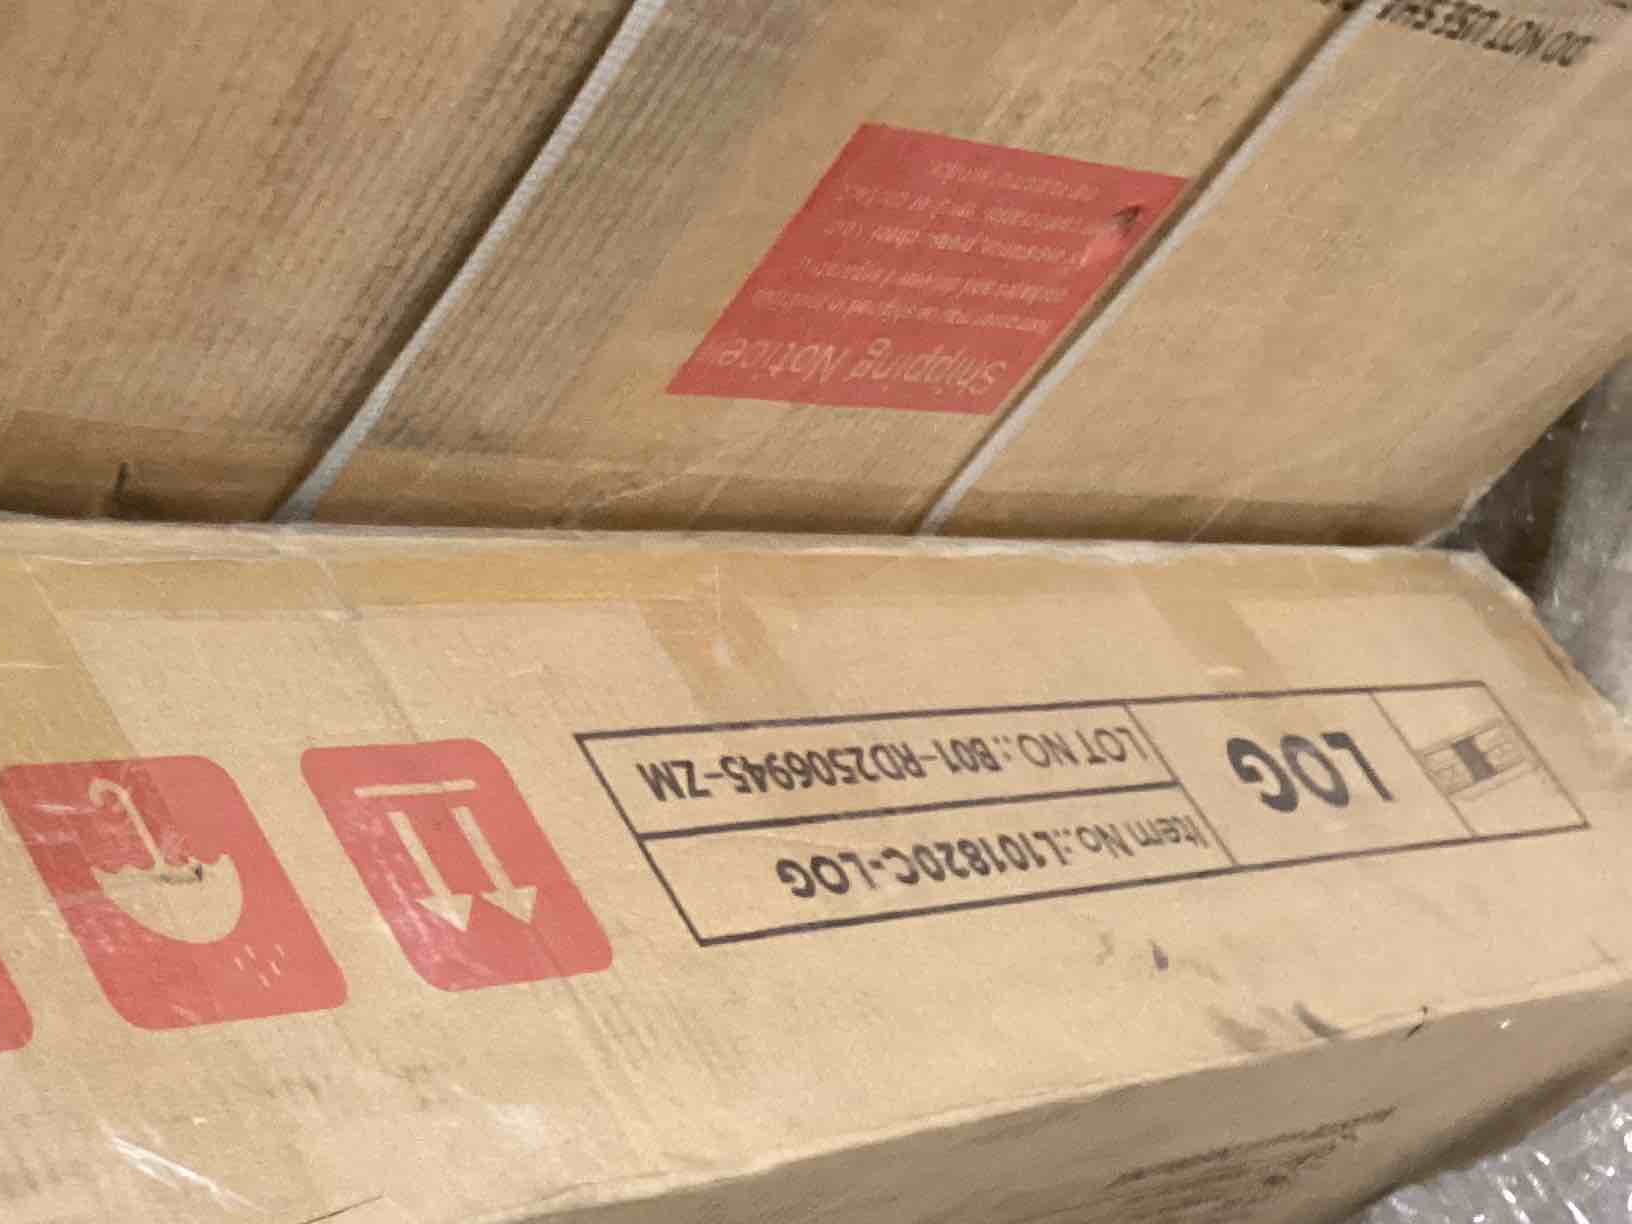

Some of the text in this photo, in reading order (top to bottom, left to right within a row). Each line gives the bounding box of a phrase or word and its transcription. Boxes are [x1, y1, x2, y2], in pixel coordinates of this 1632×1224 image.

[1482, 20, 1550, 55] NOT
[720, 338, 1007, 396] Shipping Notice
[1076, 726, 1149, 766] LOT
[1226, 731, 1396, 814] LOG
[1131, 813, 1212, 850] Item
